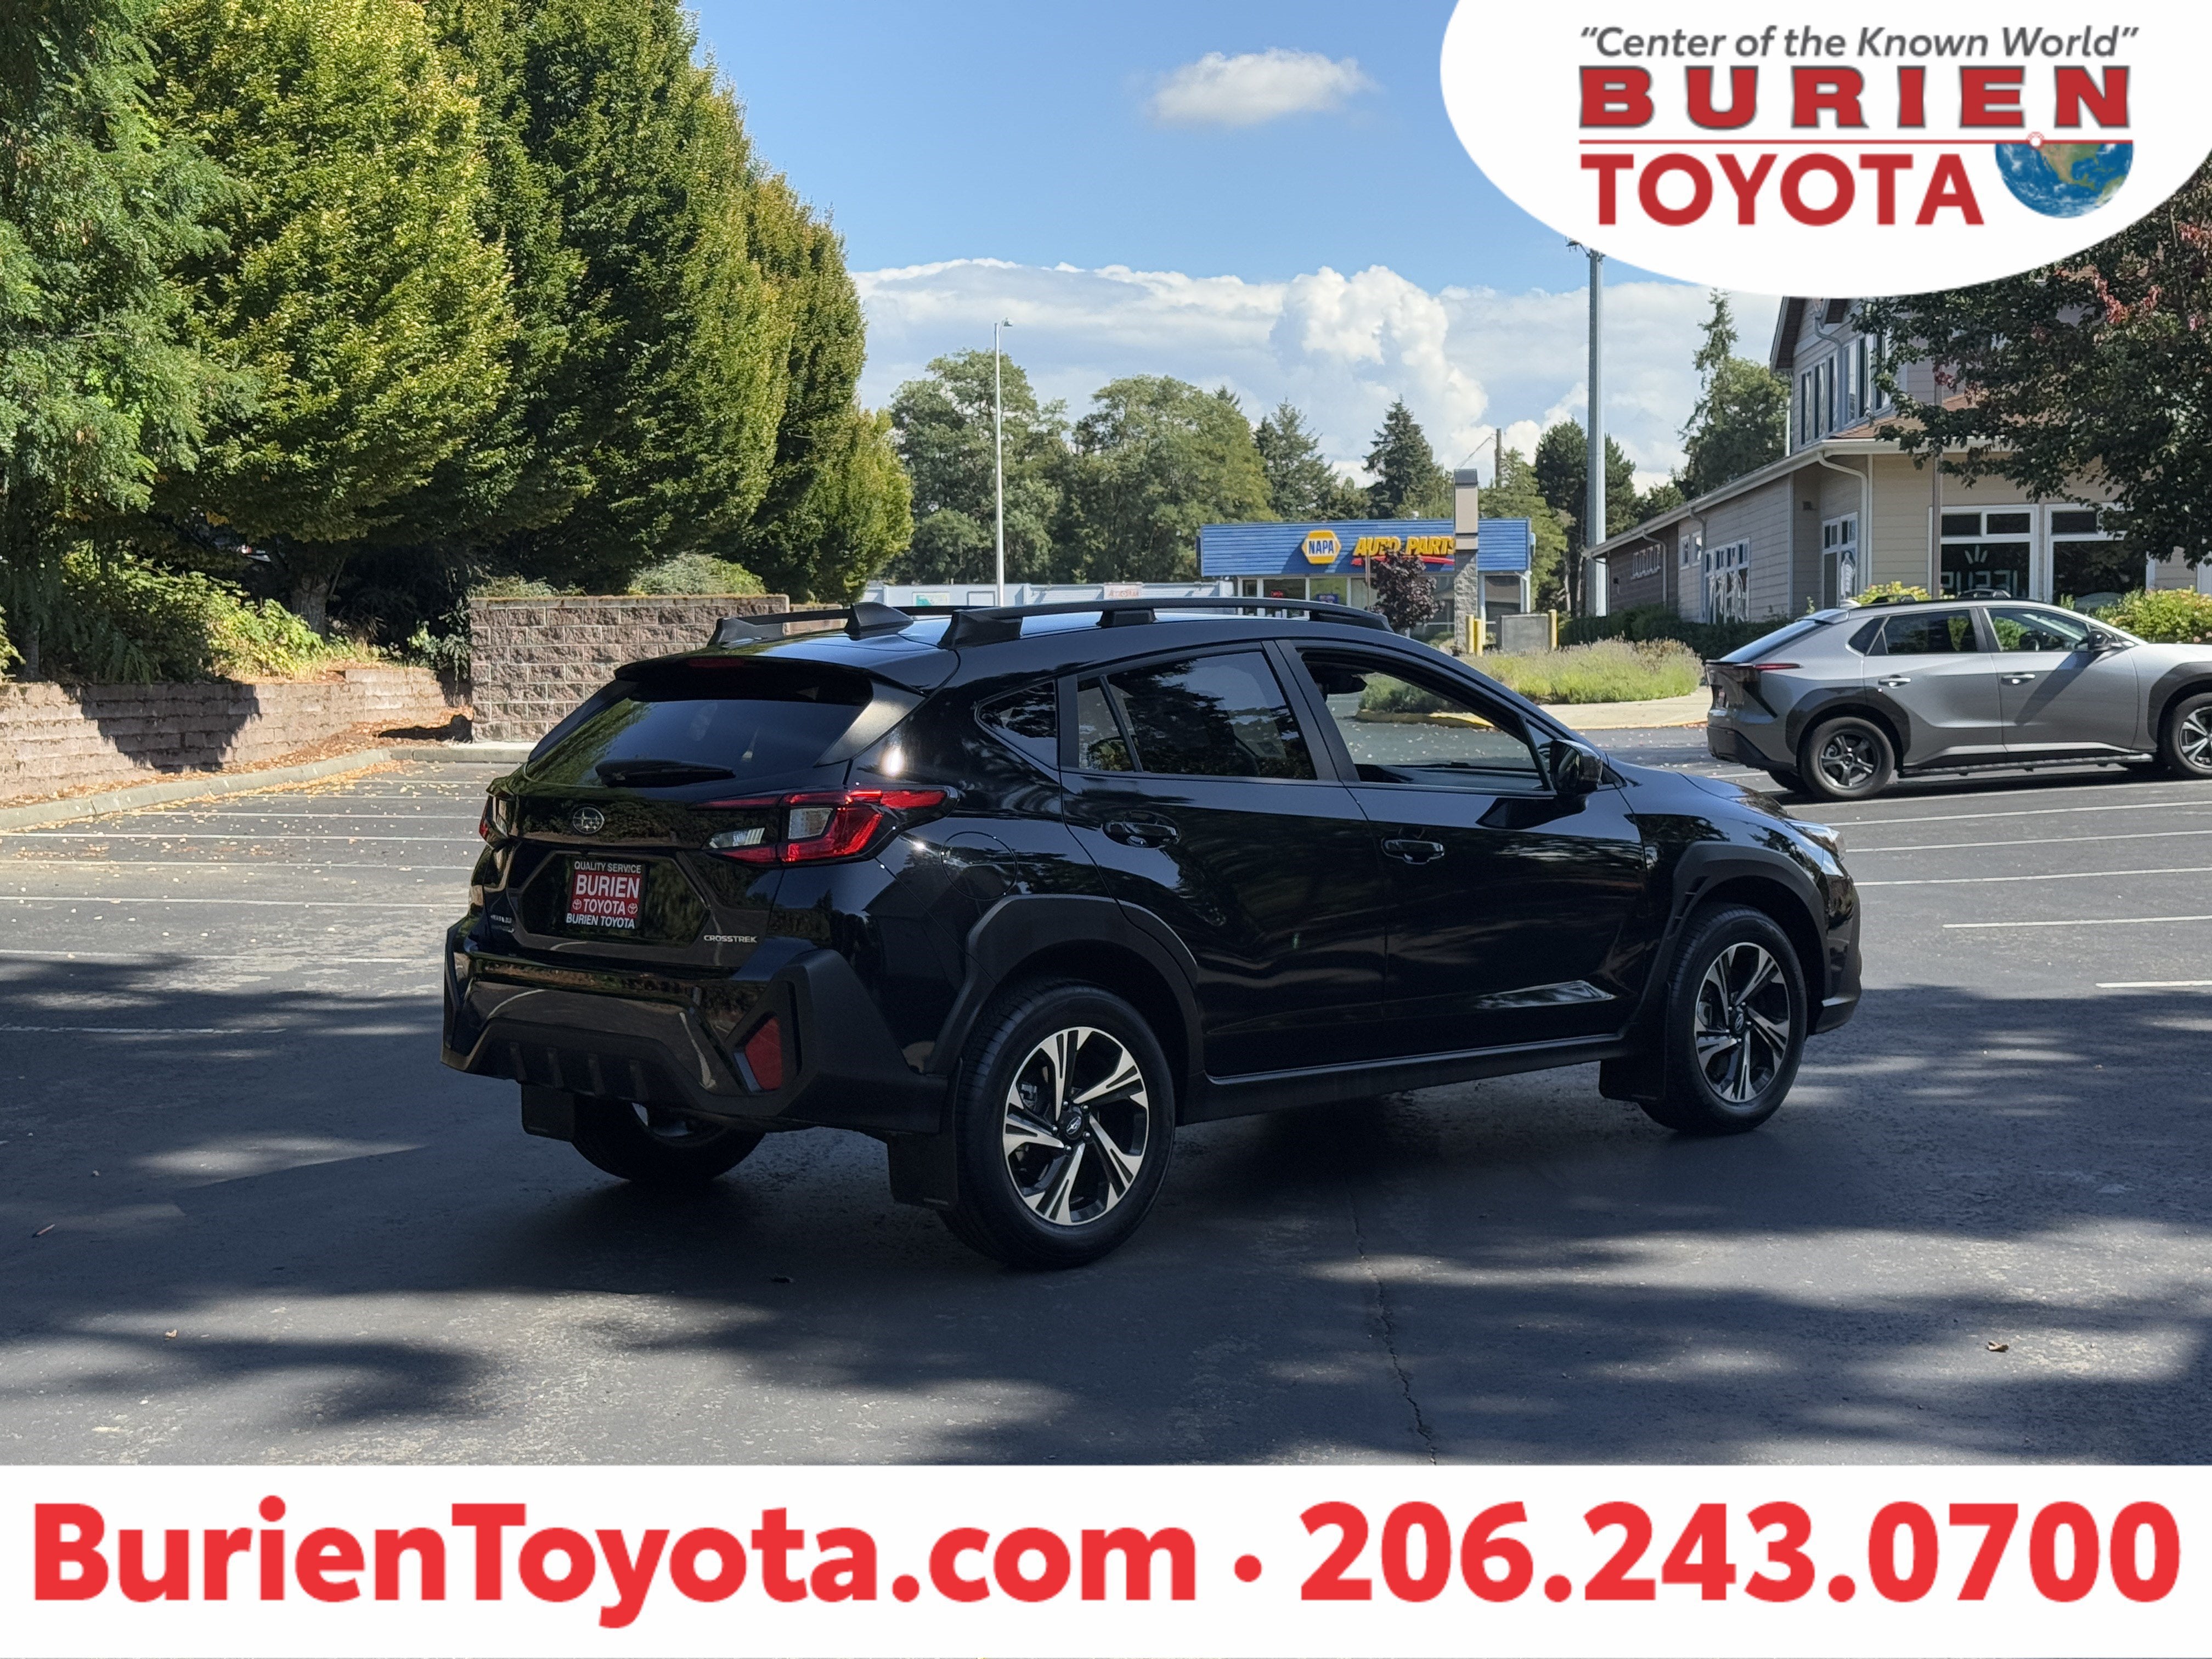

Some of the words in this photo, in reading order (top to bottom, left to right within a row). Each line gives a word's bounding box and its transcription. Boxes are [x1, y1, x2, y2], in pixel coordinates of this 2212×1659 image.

[1308, 539, 1335, 555] NAPA
[1352, 535, 1402, 556] AUTO
[574, 861, 606, 871] QUALITY
[607, 862, 641, 874] SERVICE
[576, 874, 640, 899] BURIEN
[583, 899, 625, 915] TOYOTA
[566, 913, 599, 926] BURIEN
[601, 916, 635, 929] TOYOTA
[704, 935, 757, 943] CROSSTREK
